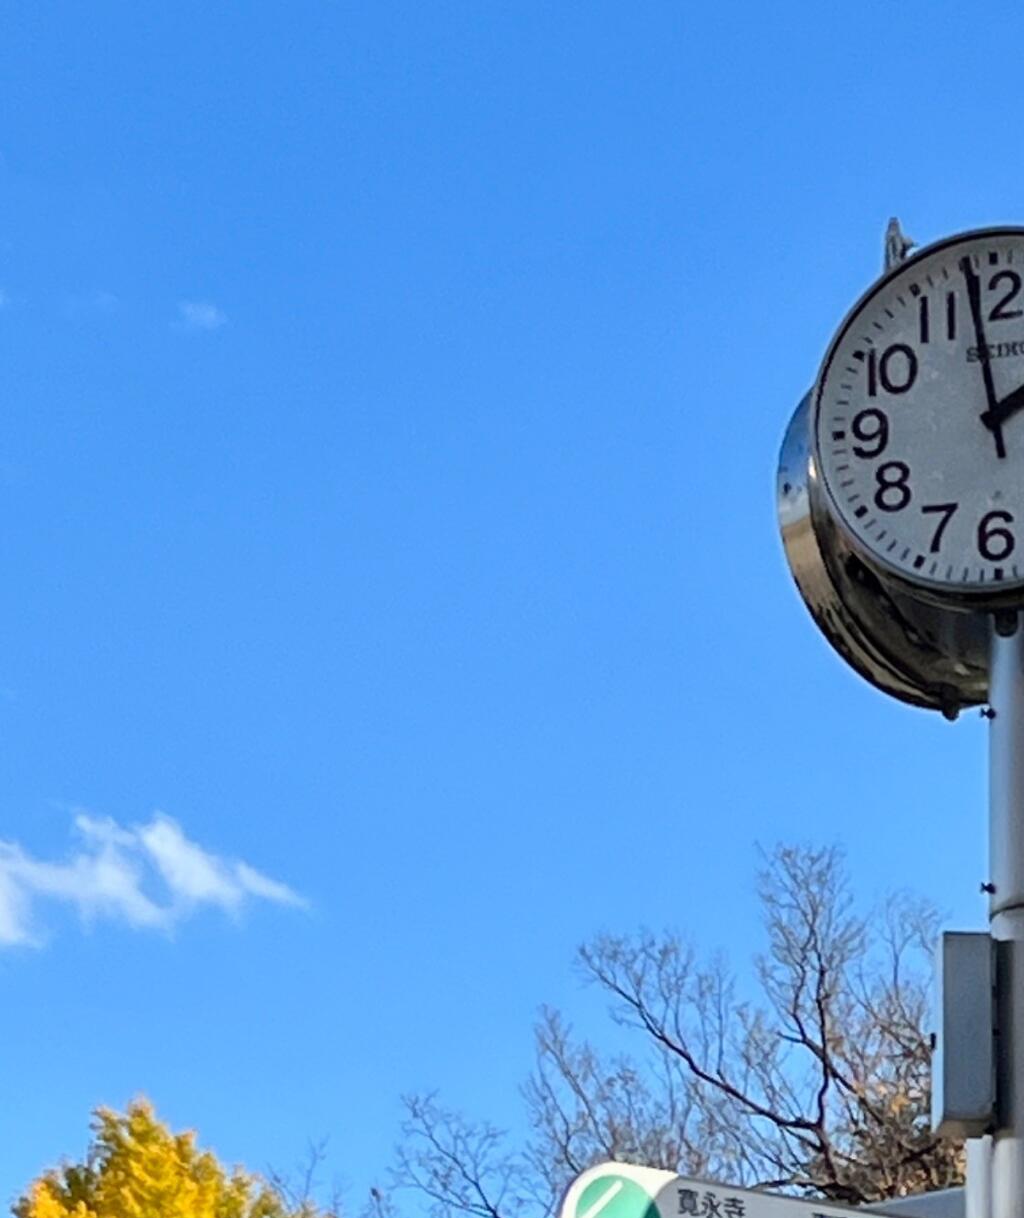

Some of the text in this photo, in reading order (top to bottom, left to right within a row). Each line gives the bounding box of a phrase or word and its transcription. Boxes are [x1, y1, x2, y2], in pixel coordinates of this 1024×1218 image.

[919, 291, 957, 344] 11
[867, 343, 918, 397] 10
[851, 408, 889, 459] 9
[874, 461, 912, 513] 8
[921, 502, 959, 554] 7
[977, 510, 1016, 562] 6
